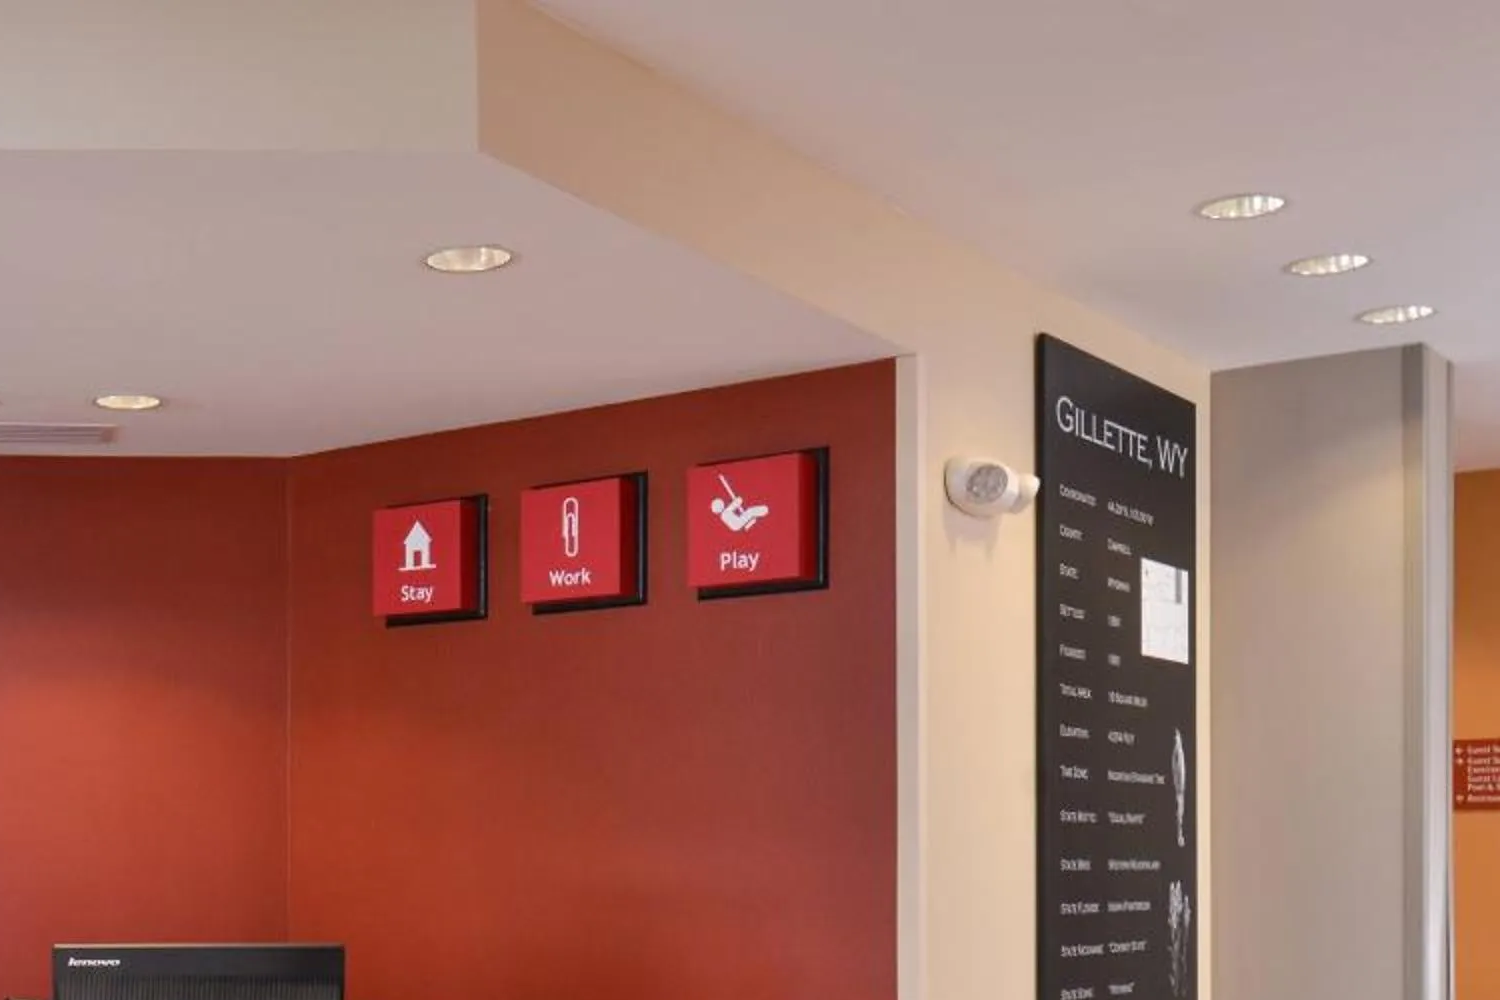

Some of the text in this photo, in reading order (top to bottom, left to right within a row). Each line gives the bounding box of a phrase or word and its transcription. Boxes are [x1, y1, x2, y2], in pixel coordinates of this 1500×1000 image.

[1055, 396, 1189, 478] GILLETTE, WY
[720, 551, 760, 572] Play
[549, 567, 592, 587] Work
[400, 585, 434, 603] Stay
[68, 956, 121, 967] lenovo
